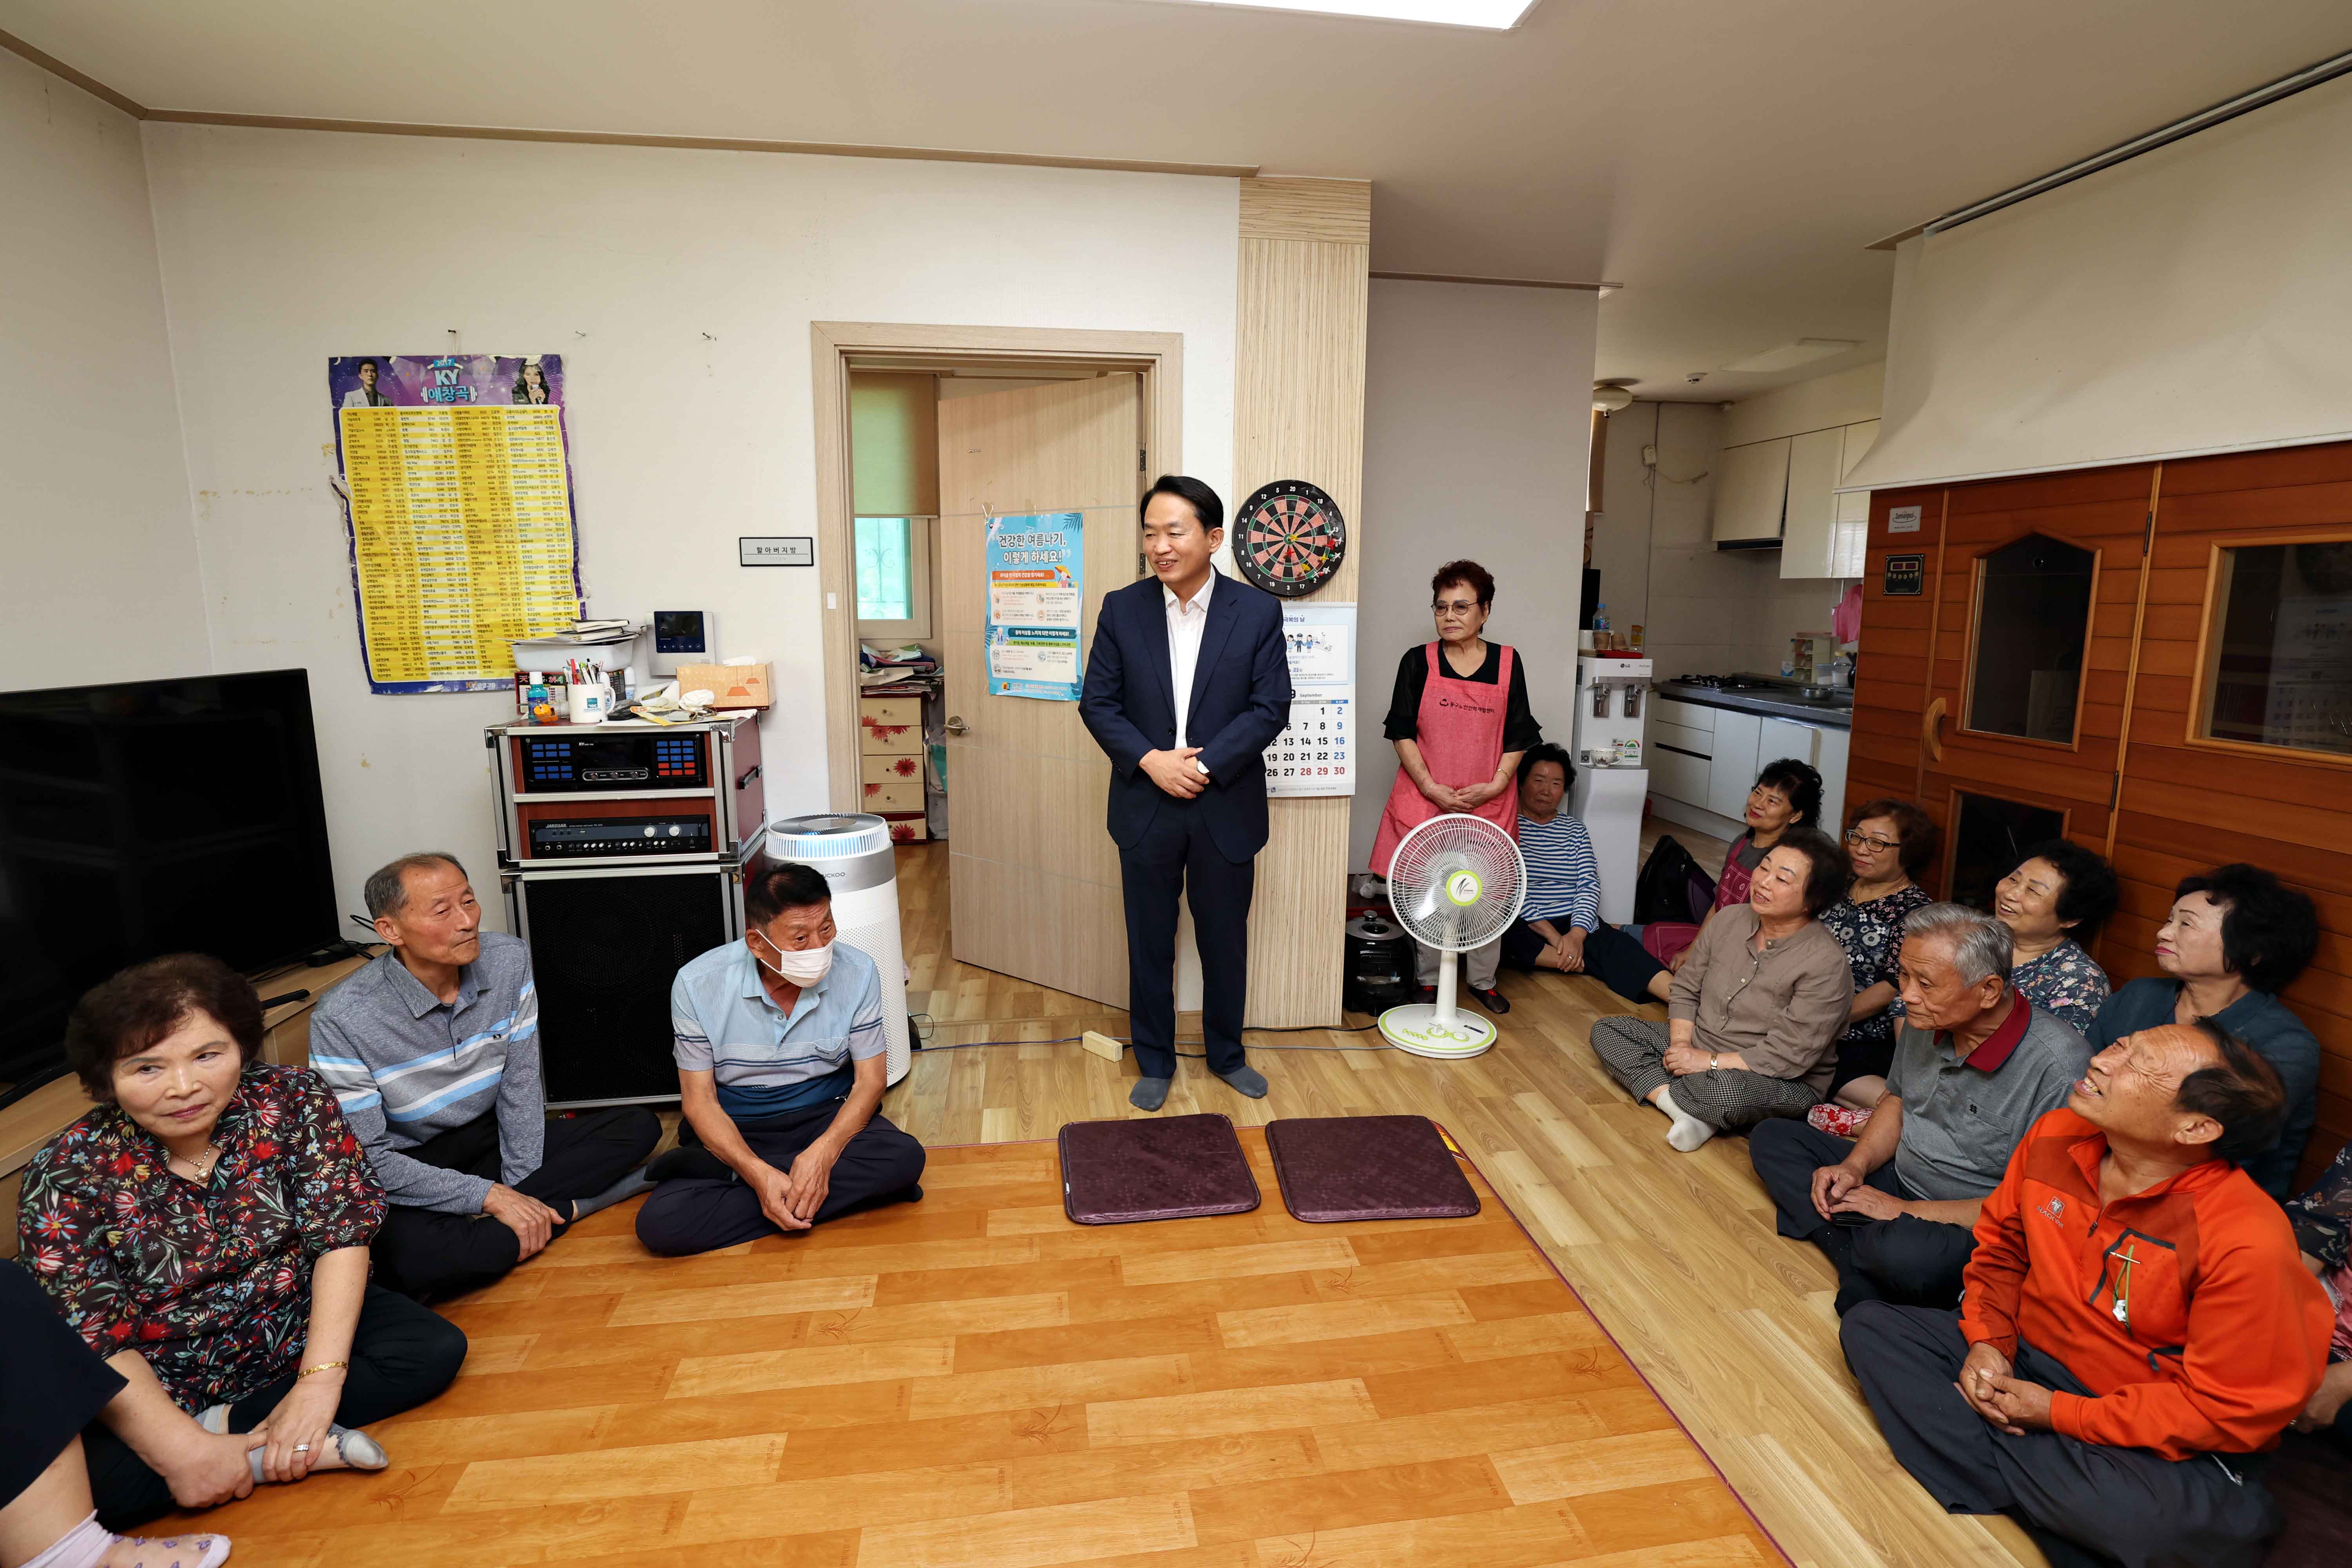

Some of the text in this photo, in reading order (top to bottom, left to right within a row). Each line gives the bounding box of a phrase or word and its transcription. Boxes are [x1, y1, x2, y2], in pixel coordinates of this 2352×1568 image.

[434, 368, 459, 386] KY
[428, 386, 470, 404] 애창곡
[999, 533, 1066, 548] 건강한 여름나기,
[1004, 550, 1063, 564] 이렇게 하세요!
[1450, 701, 1495, 713] 동구노인인력개발센터
[2036, 1205, 2054, 1221] BLACK
